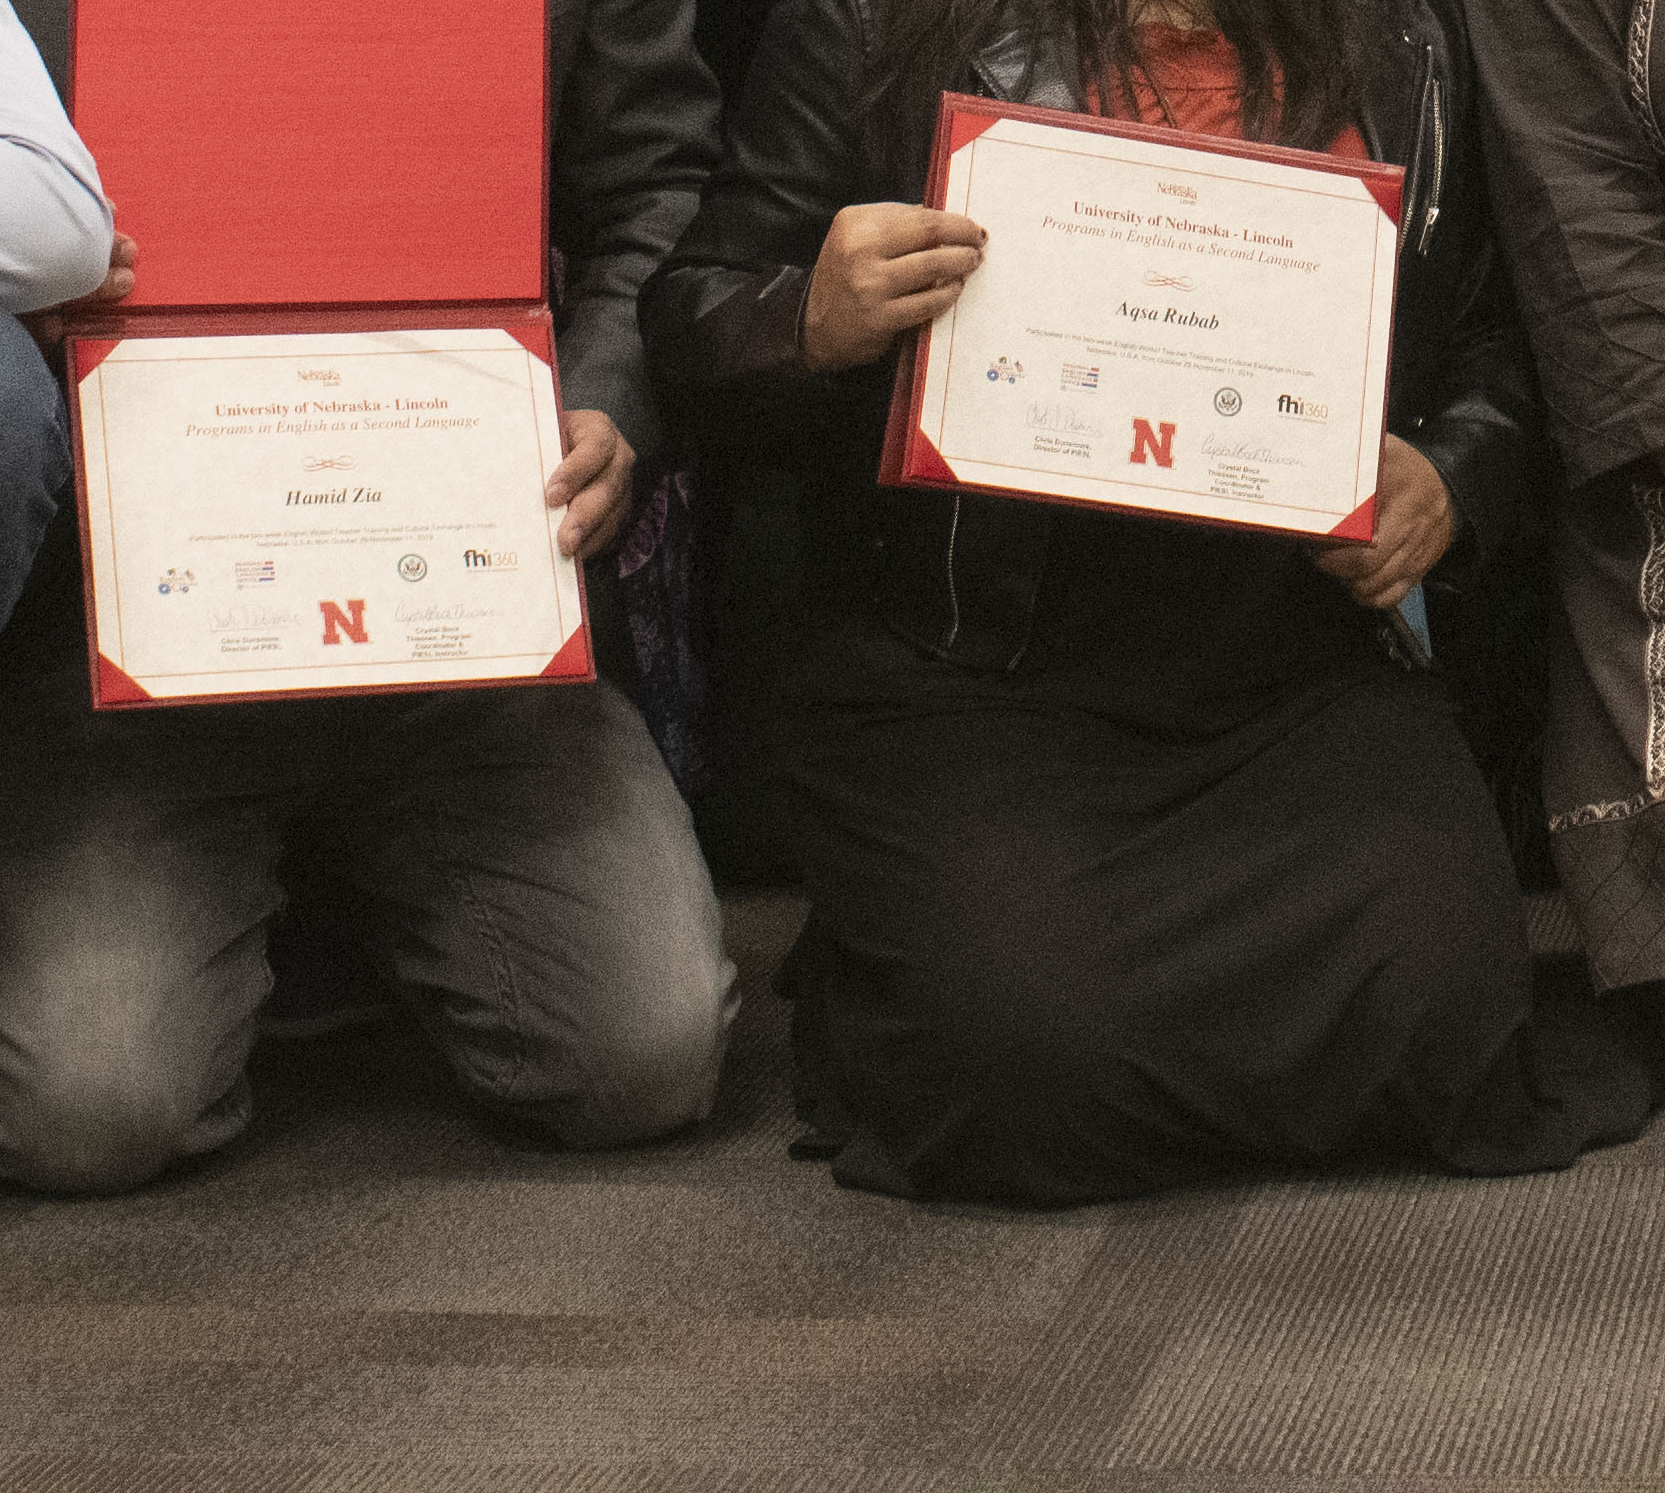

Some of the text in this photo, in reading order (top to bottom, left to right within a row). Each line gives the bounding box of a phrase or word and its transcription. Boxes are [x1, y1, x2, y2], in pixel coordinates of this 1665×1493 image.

[1073, 201, 1294, 249] University of Nebraska Lincoln
[1116, 300, 1220, 331] Aqsa Rubab
[215, 397, 448, 418] University of Nebraska Lincoln
[1128, 416, 1178, 471] N
[285, 487, 382, 507] Hamid Zia
[319, 599, 370, 645] N
